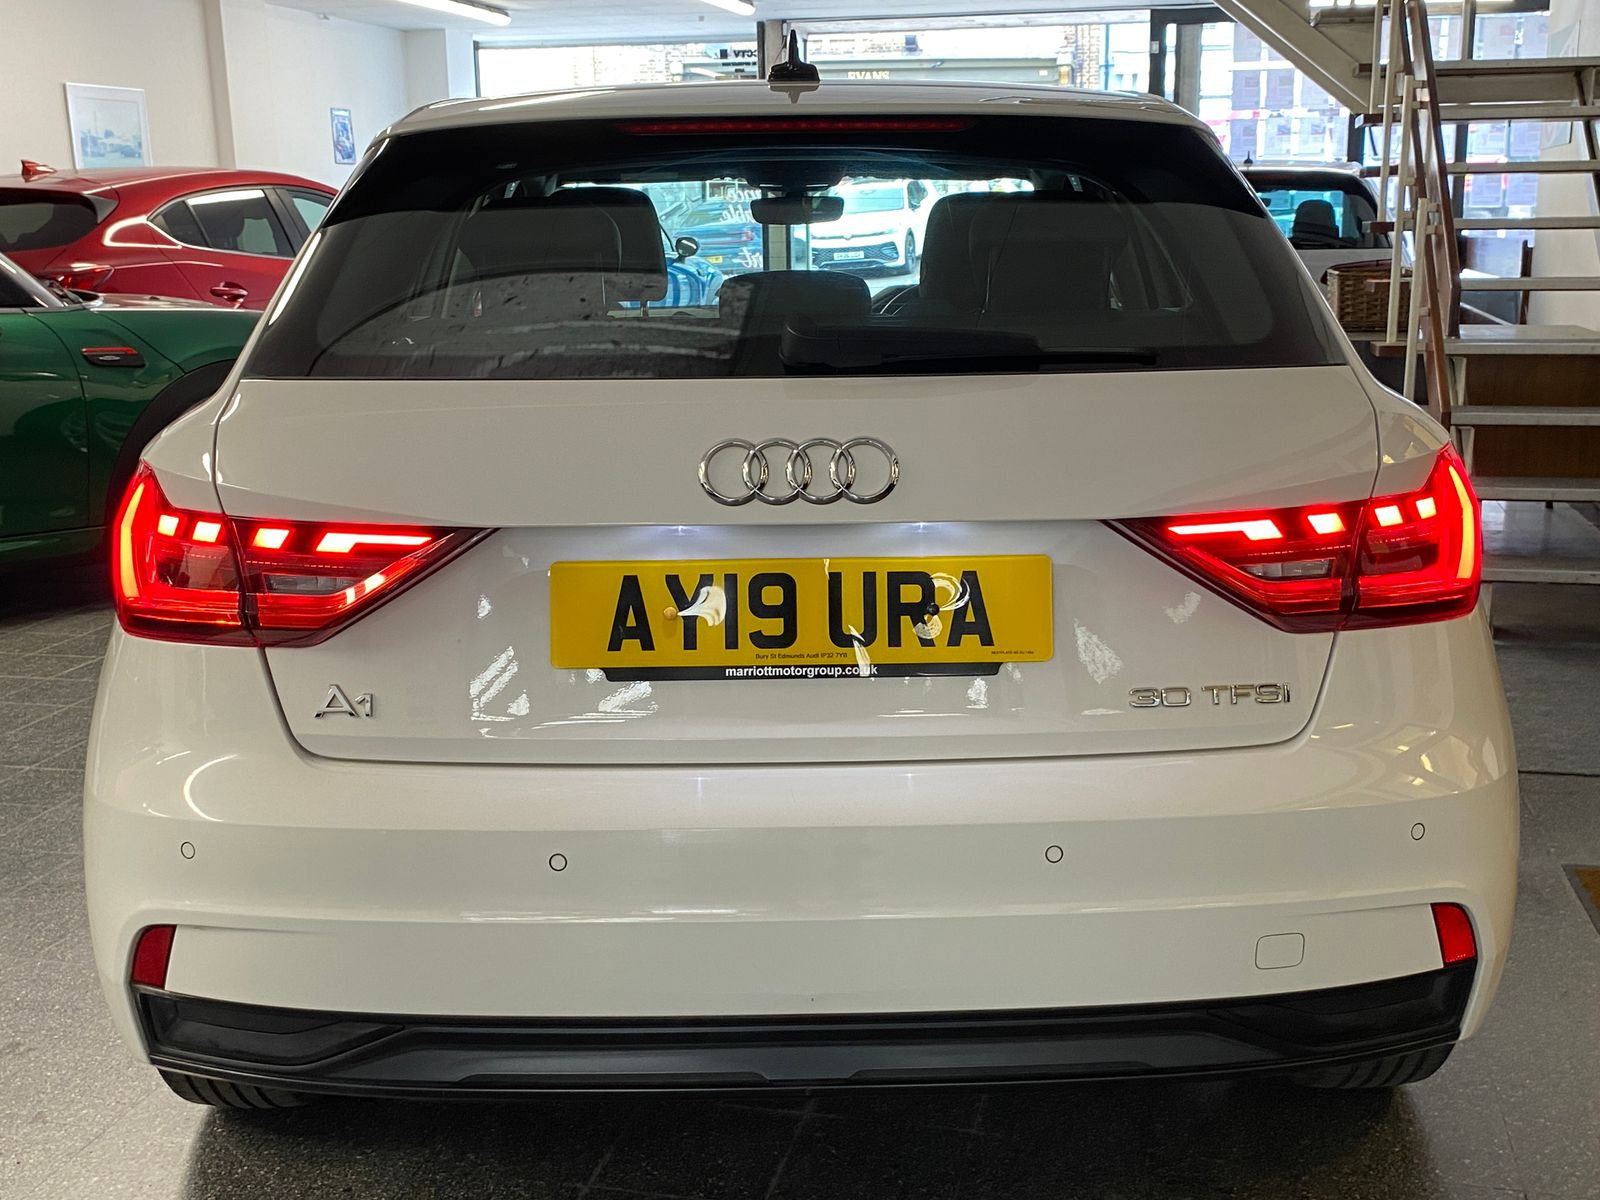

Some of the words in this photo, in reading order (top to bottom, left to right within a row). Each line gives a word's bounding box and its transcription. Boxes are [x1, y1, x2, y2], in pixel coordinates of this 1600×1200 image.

[607, 572, 798, 651] AY19
[828, 570, 995, 648] URA
[725, 665, 878, 678] marriottmotorgroup.co.uk
[313, 683, 374, 718] A1
[1128, 686, 1192, 708] 30
[1201, 682, 1291, 706] TFSI
